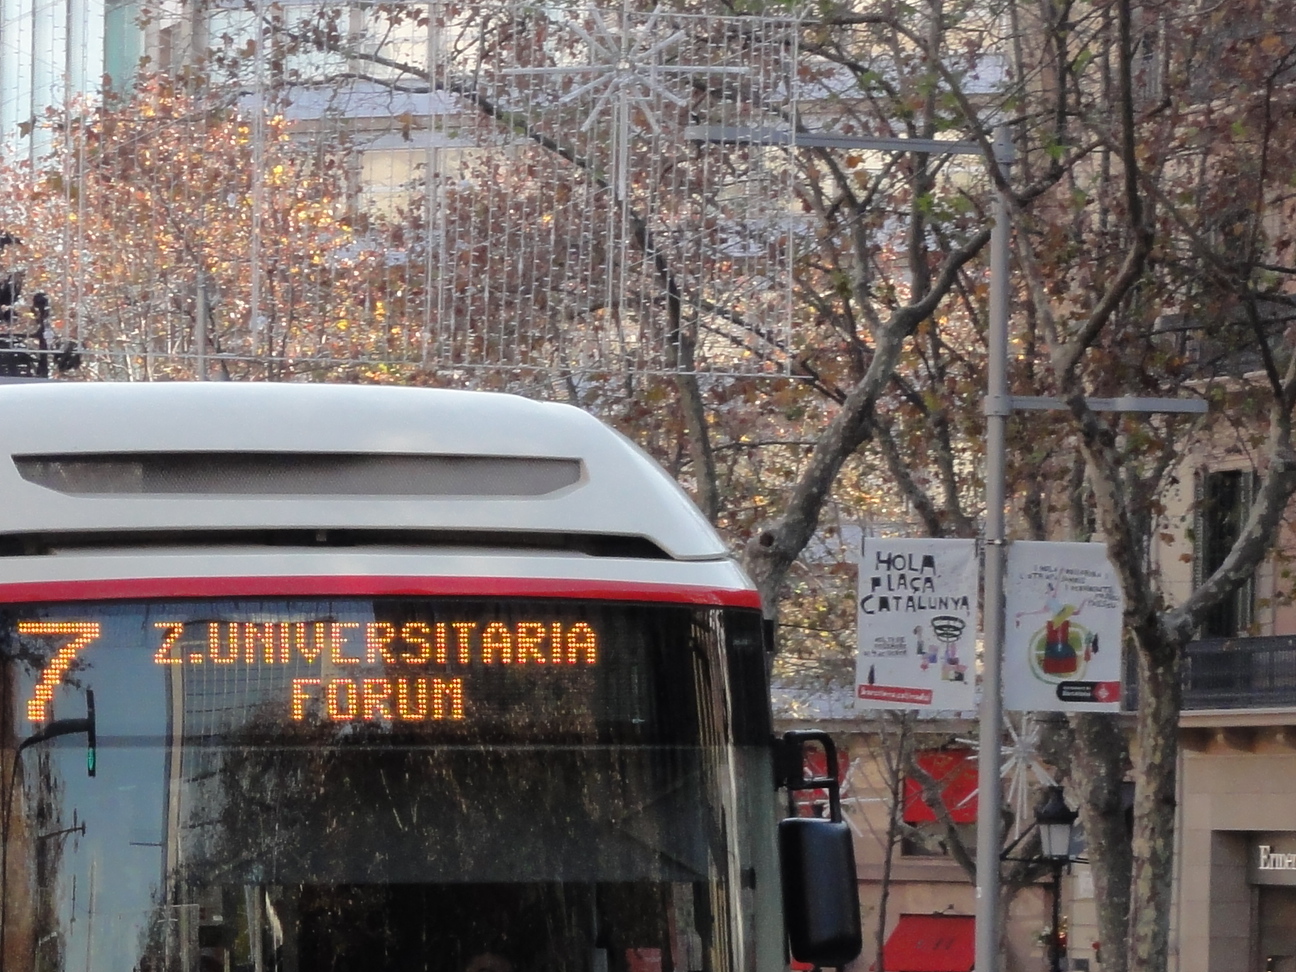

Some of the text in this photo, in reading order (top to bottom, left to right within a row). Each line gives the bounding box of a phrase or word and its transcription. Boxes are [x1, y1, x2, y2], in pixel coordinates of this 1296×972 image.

[871, 573, 935, 594] PLAÇA
[875, 551, 937, 575] HOLA
[153, 621, 596, 665] Z.UNIVERSITARIA
[18, 621, 100, 722] 7
[291, 678, 465, 720] FORUM
